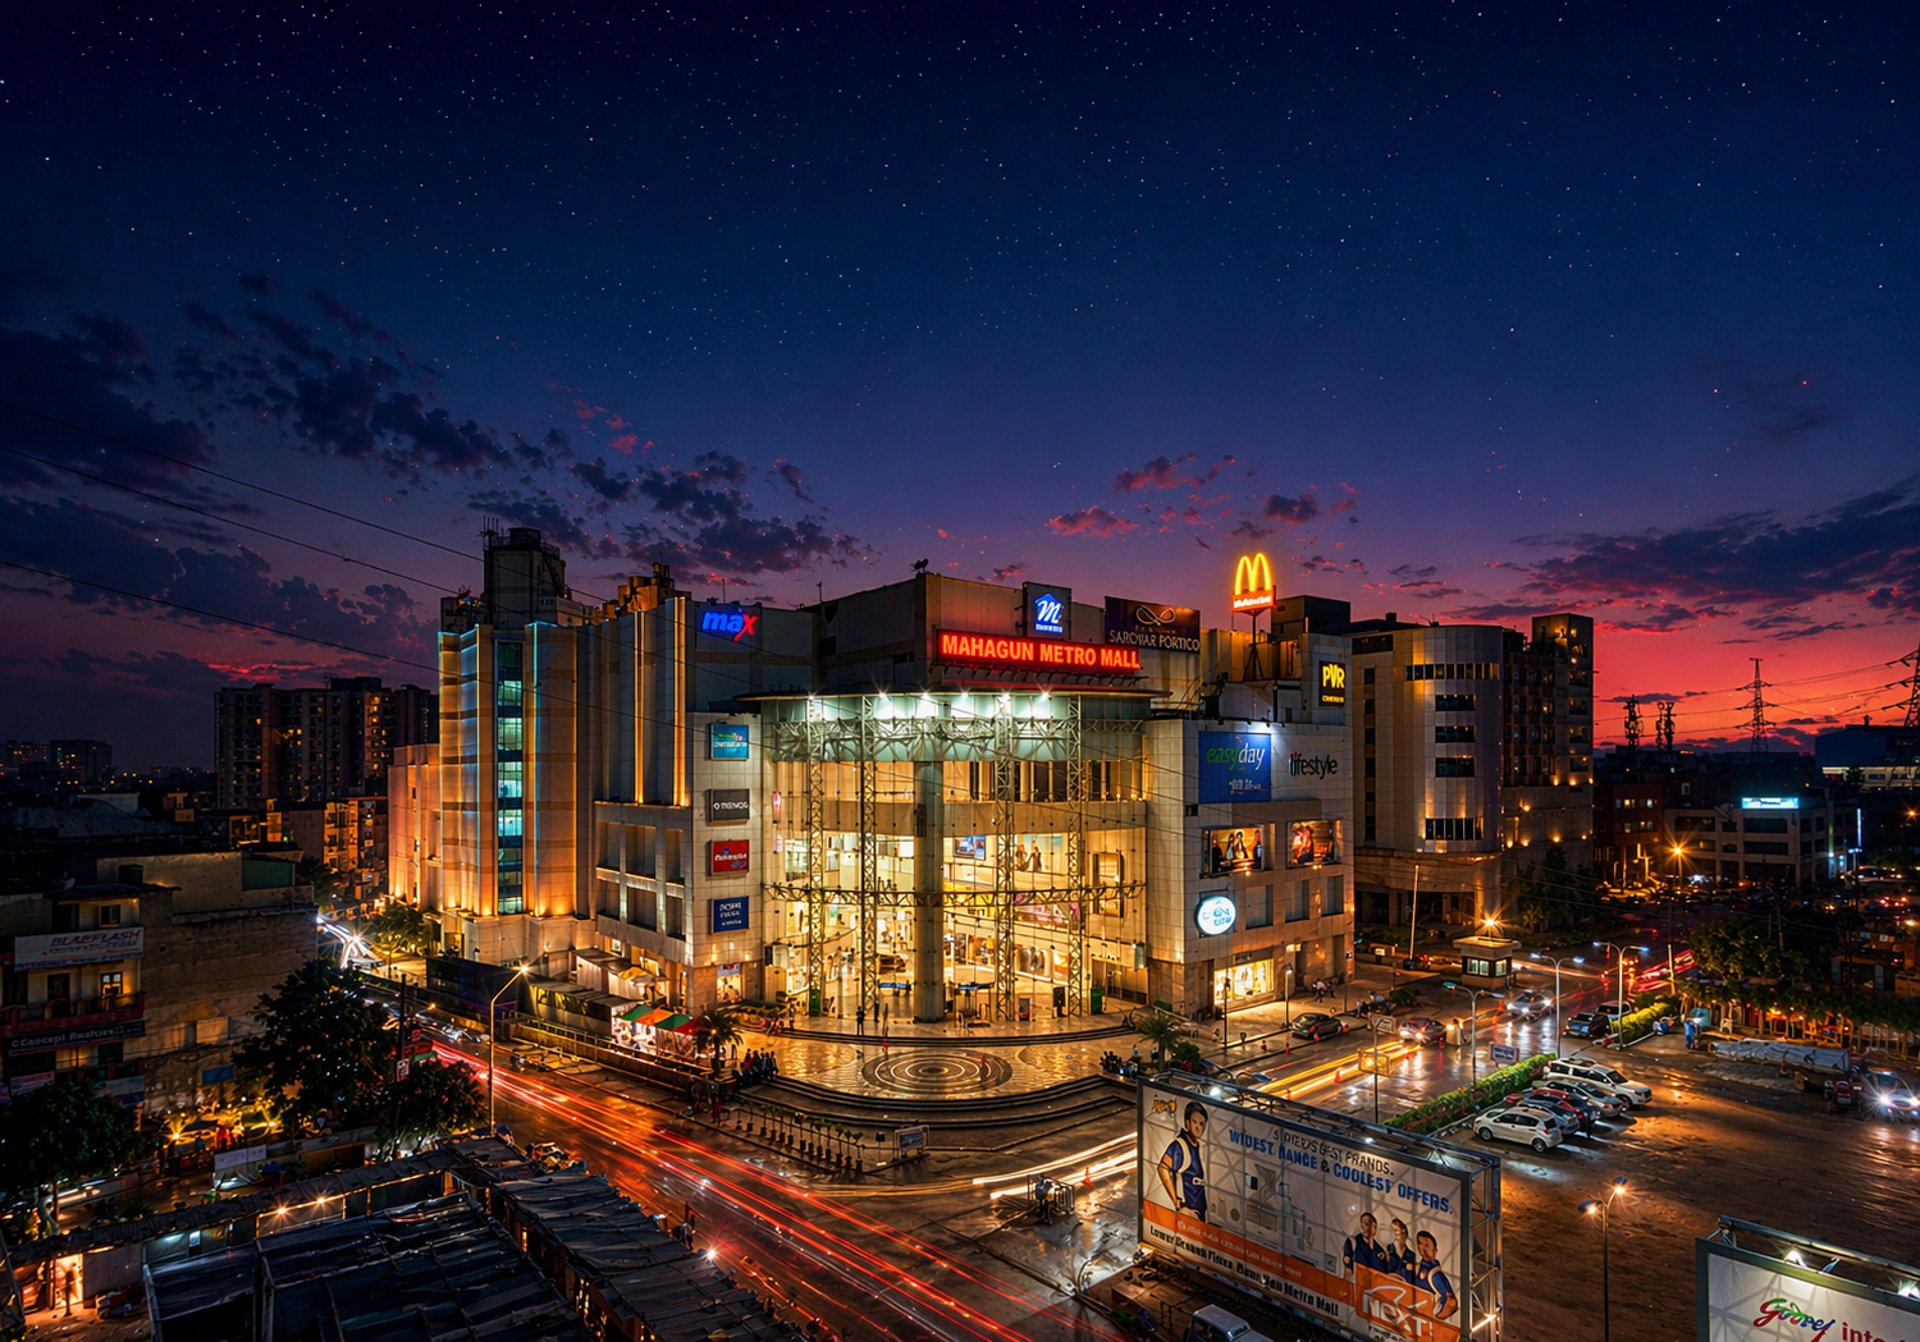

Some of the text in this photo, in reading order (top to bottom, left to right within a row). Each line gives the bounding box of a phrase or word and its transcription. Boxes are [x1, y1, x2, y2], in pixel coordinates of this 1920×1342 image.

[702, 612, 759, 642] max
[942, 634, 1140, 669] MAHAGUN METRO MALL
[1322, 663, 1345, 688] PVR
[1289, 752, 1338, 780] lifestyle
[1229, 1129, 1273, 1155] WIDEST
[1320, 1159, 1330, 1173] &
[1333, 1162, 1393, 1193] COOLEST
